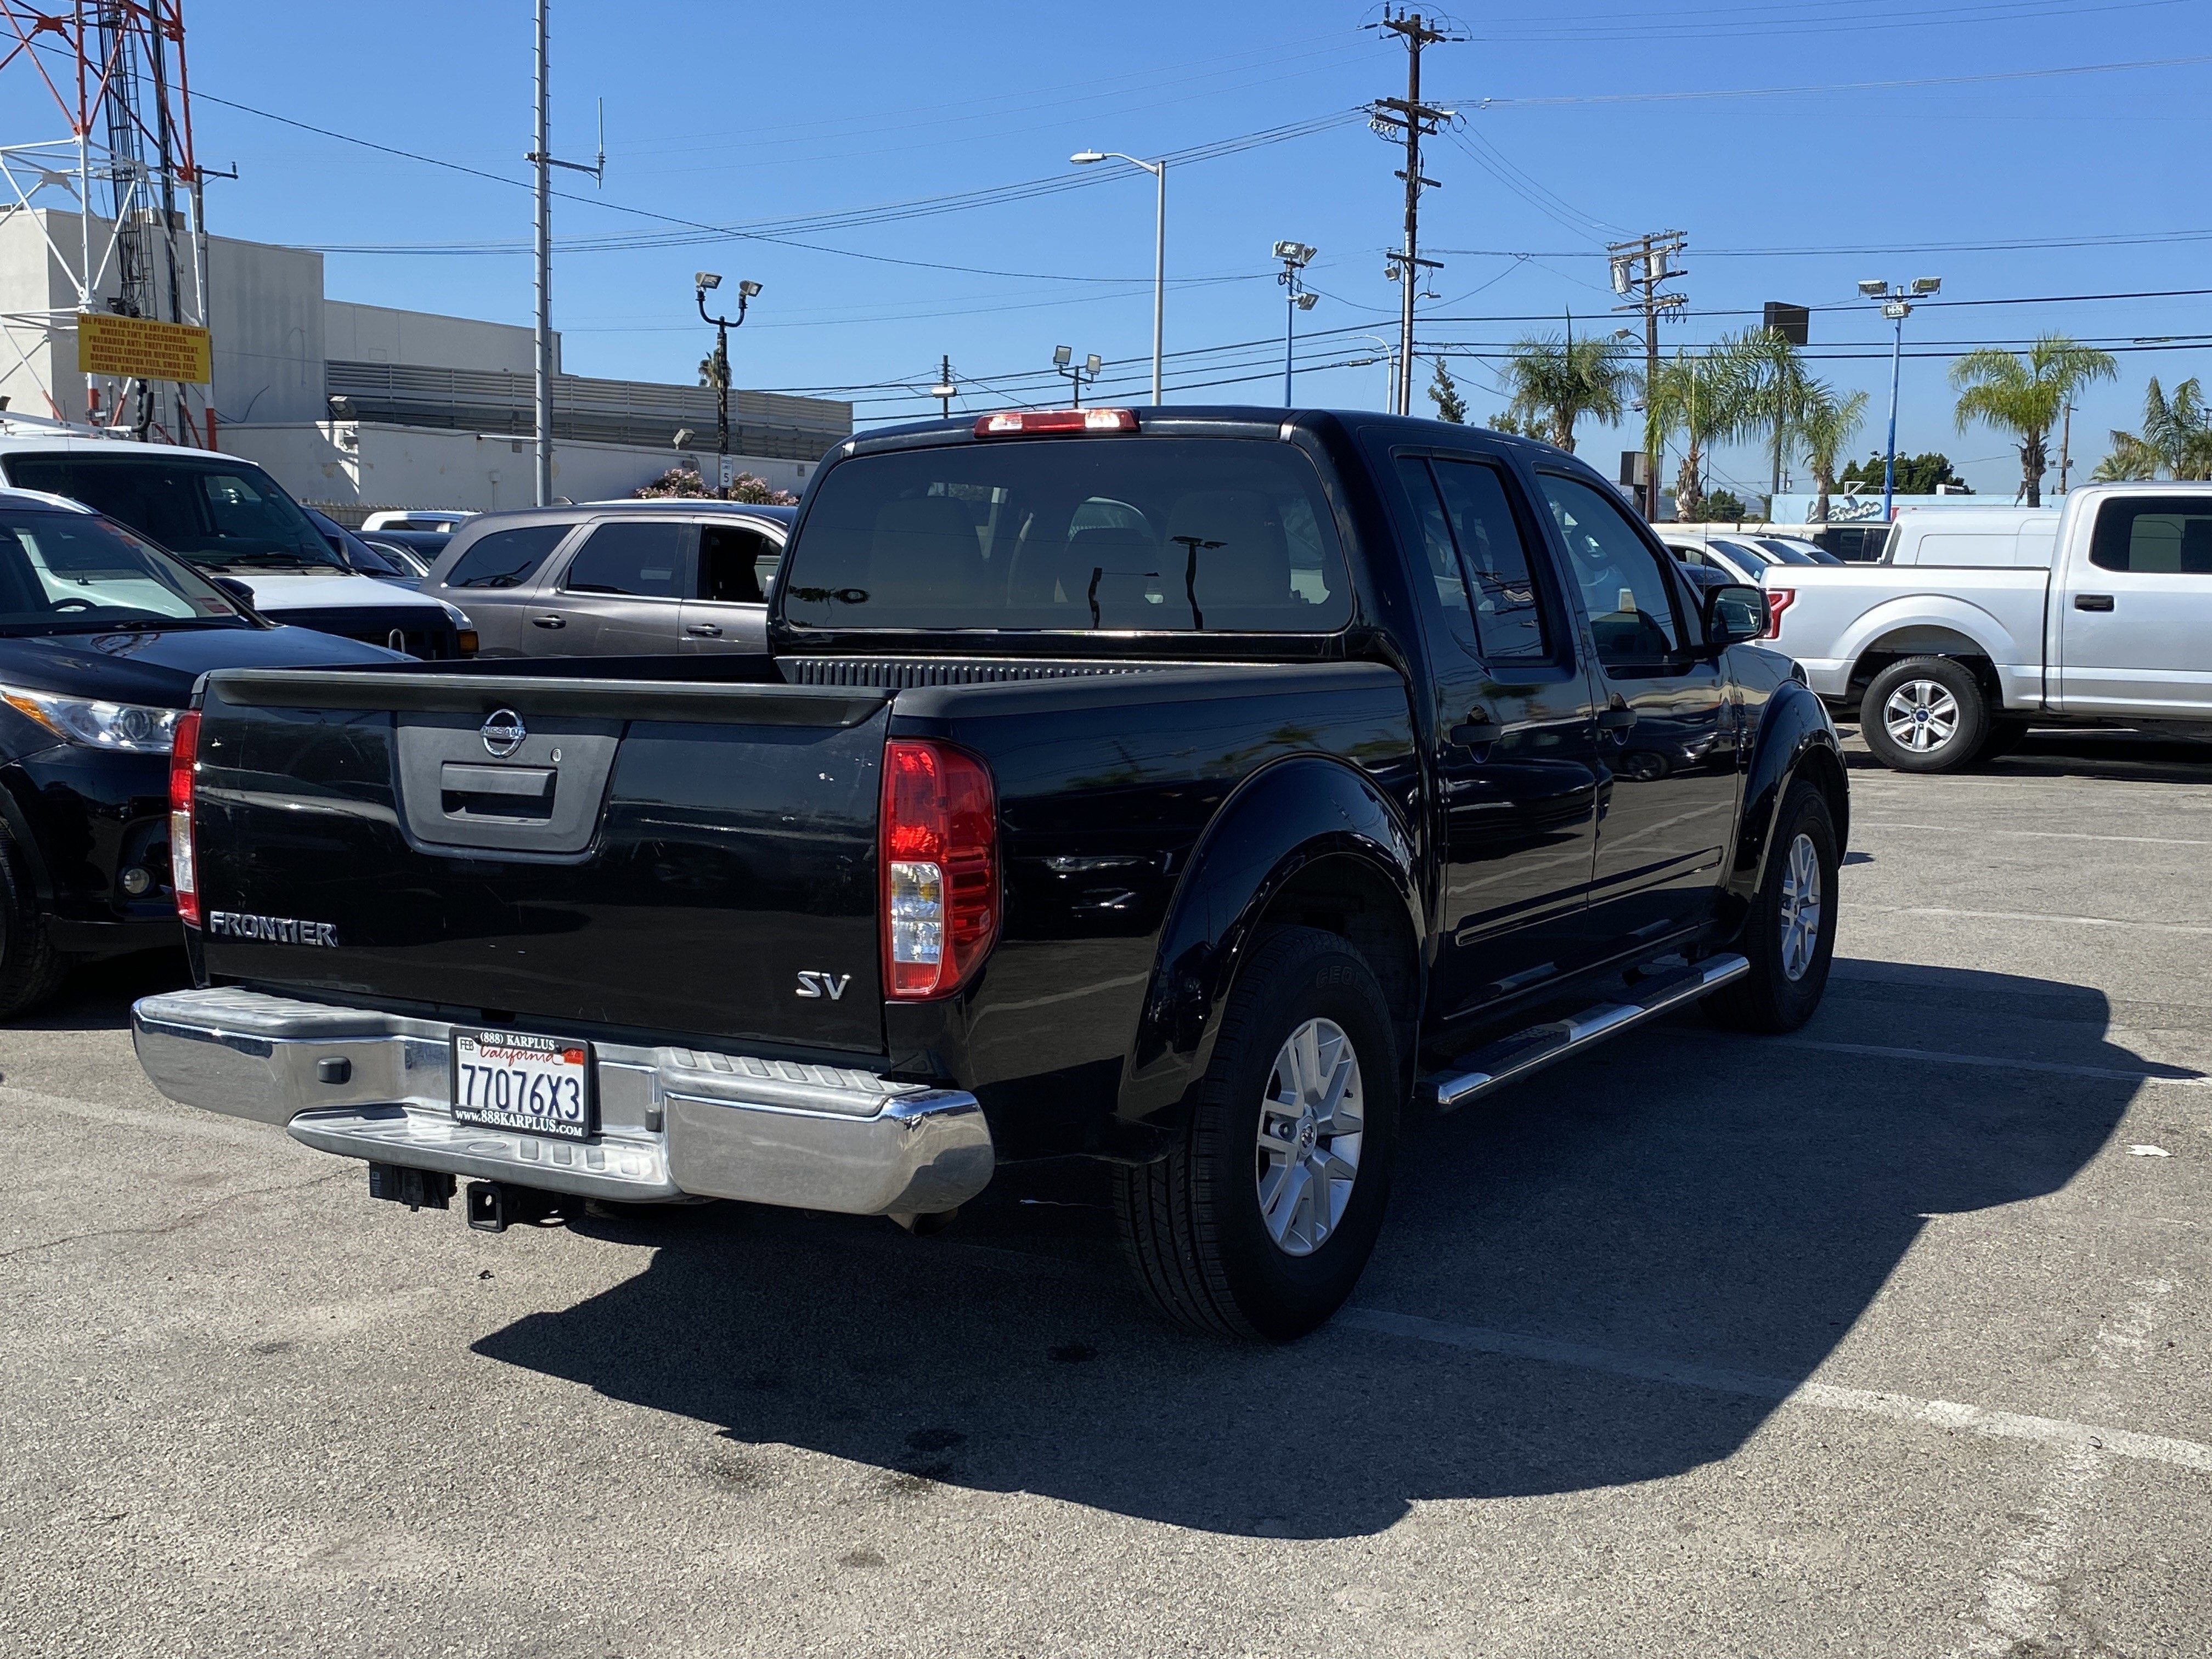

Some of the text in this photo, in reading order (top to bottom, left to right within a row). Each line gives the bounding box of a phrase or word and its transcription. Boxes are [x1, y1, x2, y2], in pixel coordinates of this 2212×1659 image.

[81, 315, 206, 338] ALL PRICES ARE PLUS ANY AFTER MARKET
[88, 335, 125, 346] PRELOADED
[126, 340, 162, 350] ANTI-THEFT
[92, 345, 122, 354] VEHICLES
[124, 348, 152, 358] LOCATOR
[90, 353, 144, 365] DOCUMENTATION
[163, 361, 182, 369] SMOG
[136, 367, 180, 378] REGISTRATION
[724, 472, 729, 483] 5
[210, 910, 339, 948] FRONTIER
[796, 970, 851, 1000] SV
[460, 1039, 475, 1051] FEB
[479, 1031, 555, 1051] (888) KARPLUS
[480, 1045, 564, 1067] California
[461, 1063, 580, 1120] 77076X3
